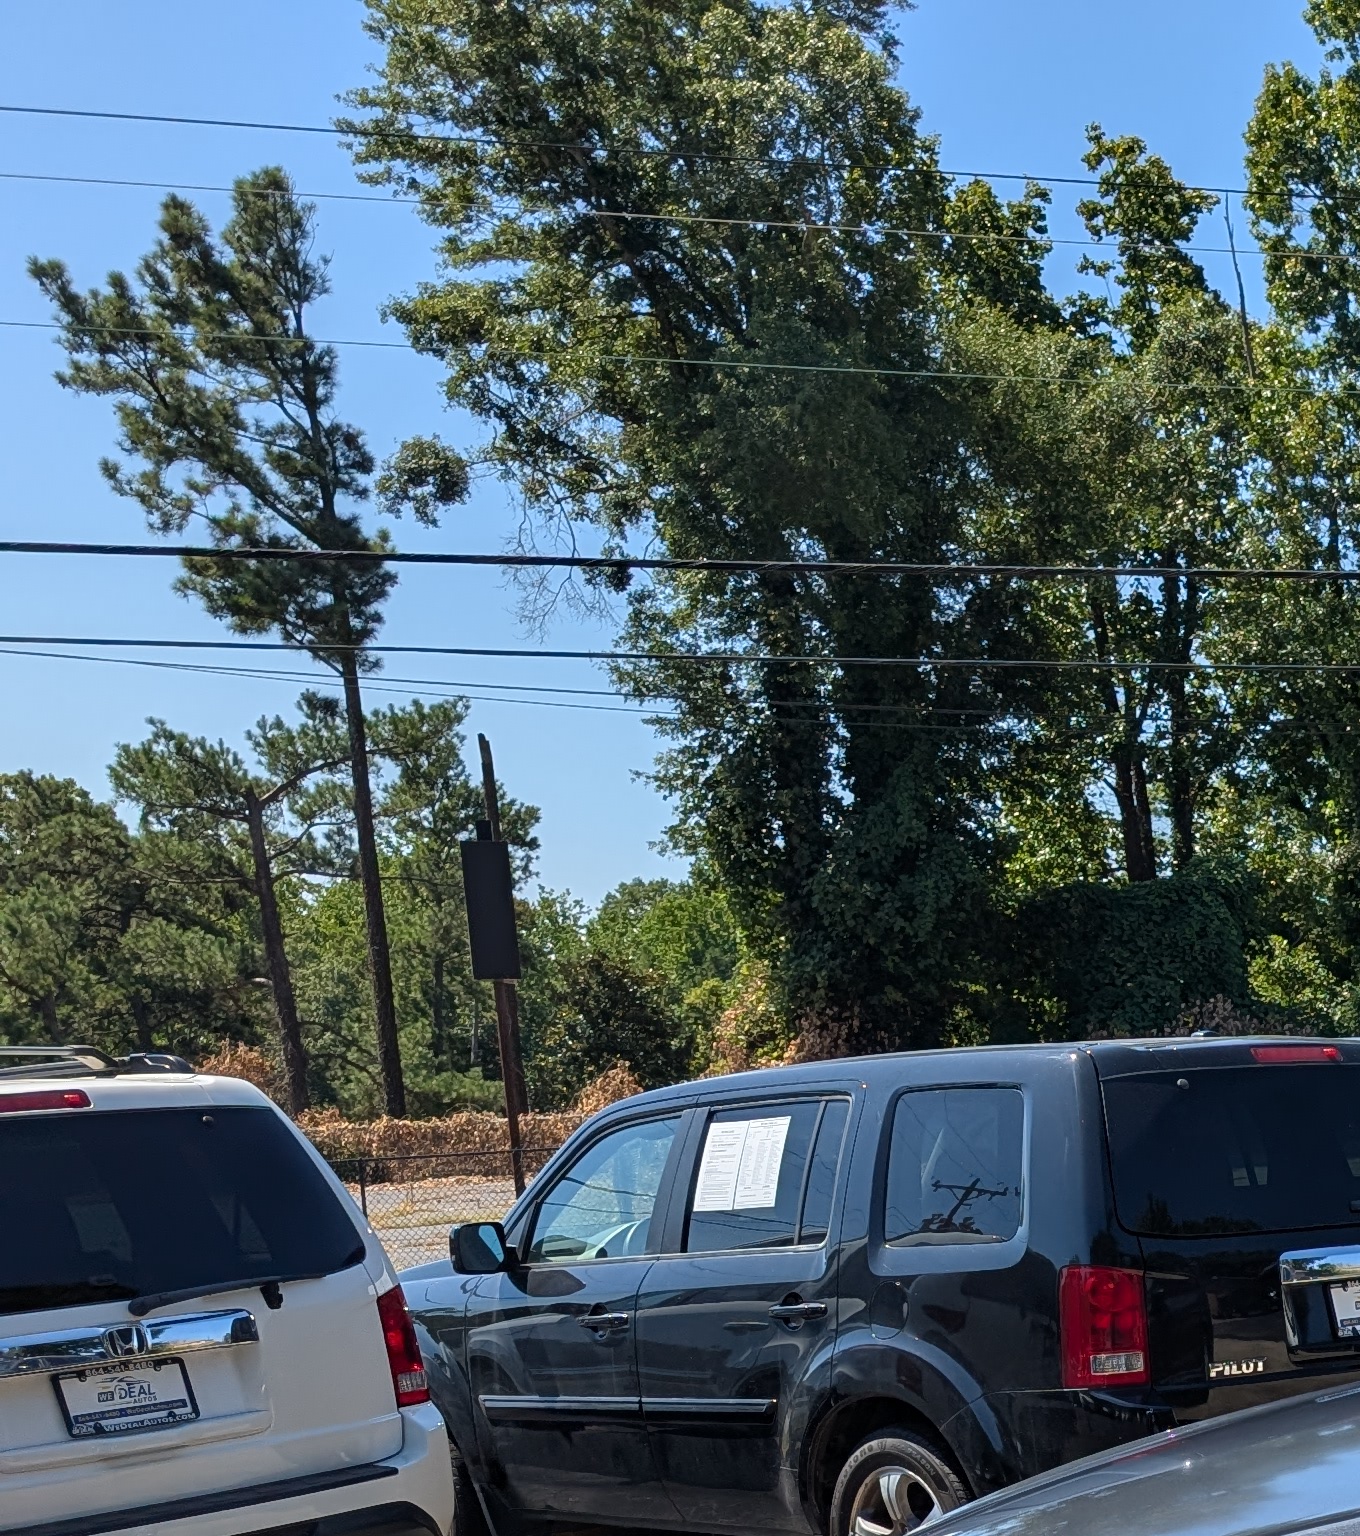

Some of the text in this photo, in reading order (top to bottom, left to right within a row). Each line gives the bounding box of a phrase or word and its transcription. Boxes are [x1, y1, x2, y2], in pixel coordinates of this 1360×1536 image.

[85, 1361, 154, 1377] 864-541-8480
[1208, 1356, 1267, 1377] PILOT
[99, 1383, 156, 1401] WE DEAL
[132, 1395, 158, 1405] AUTOS
